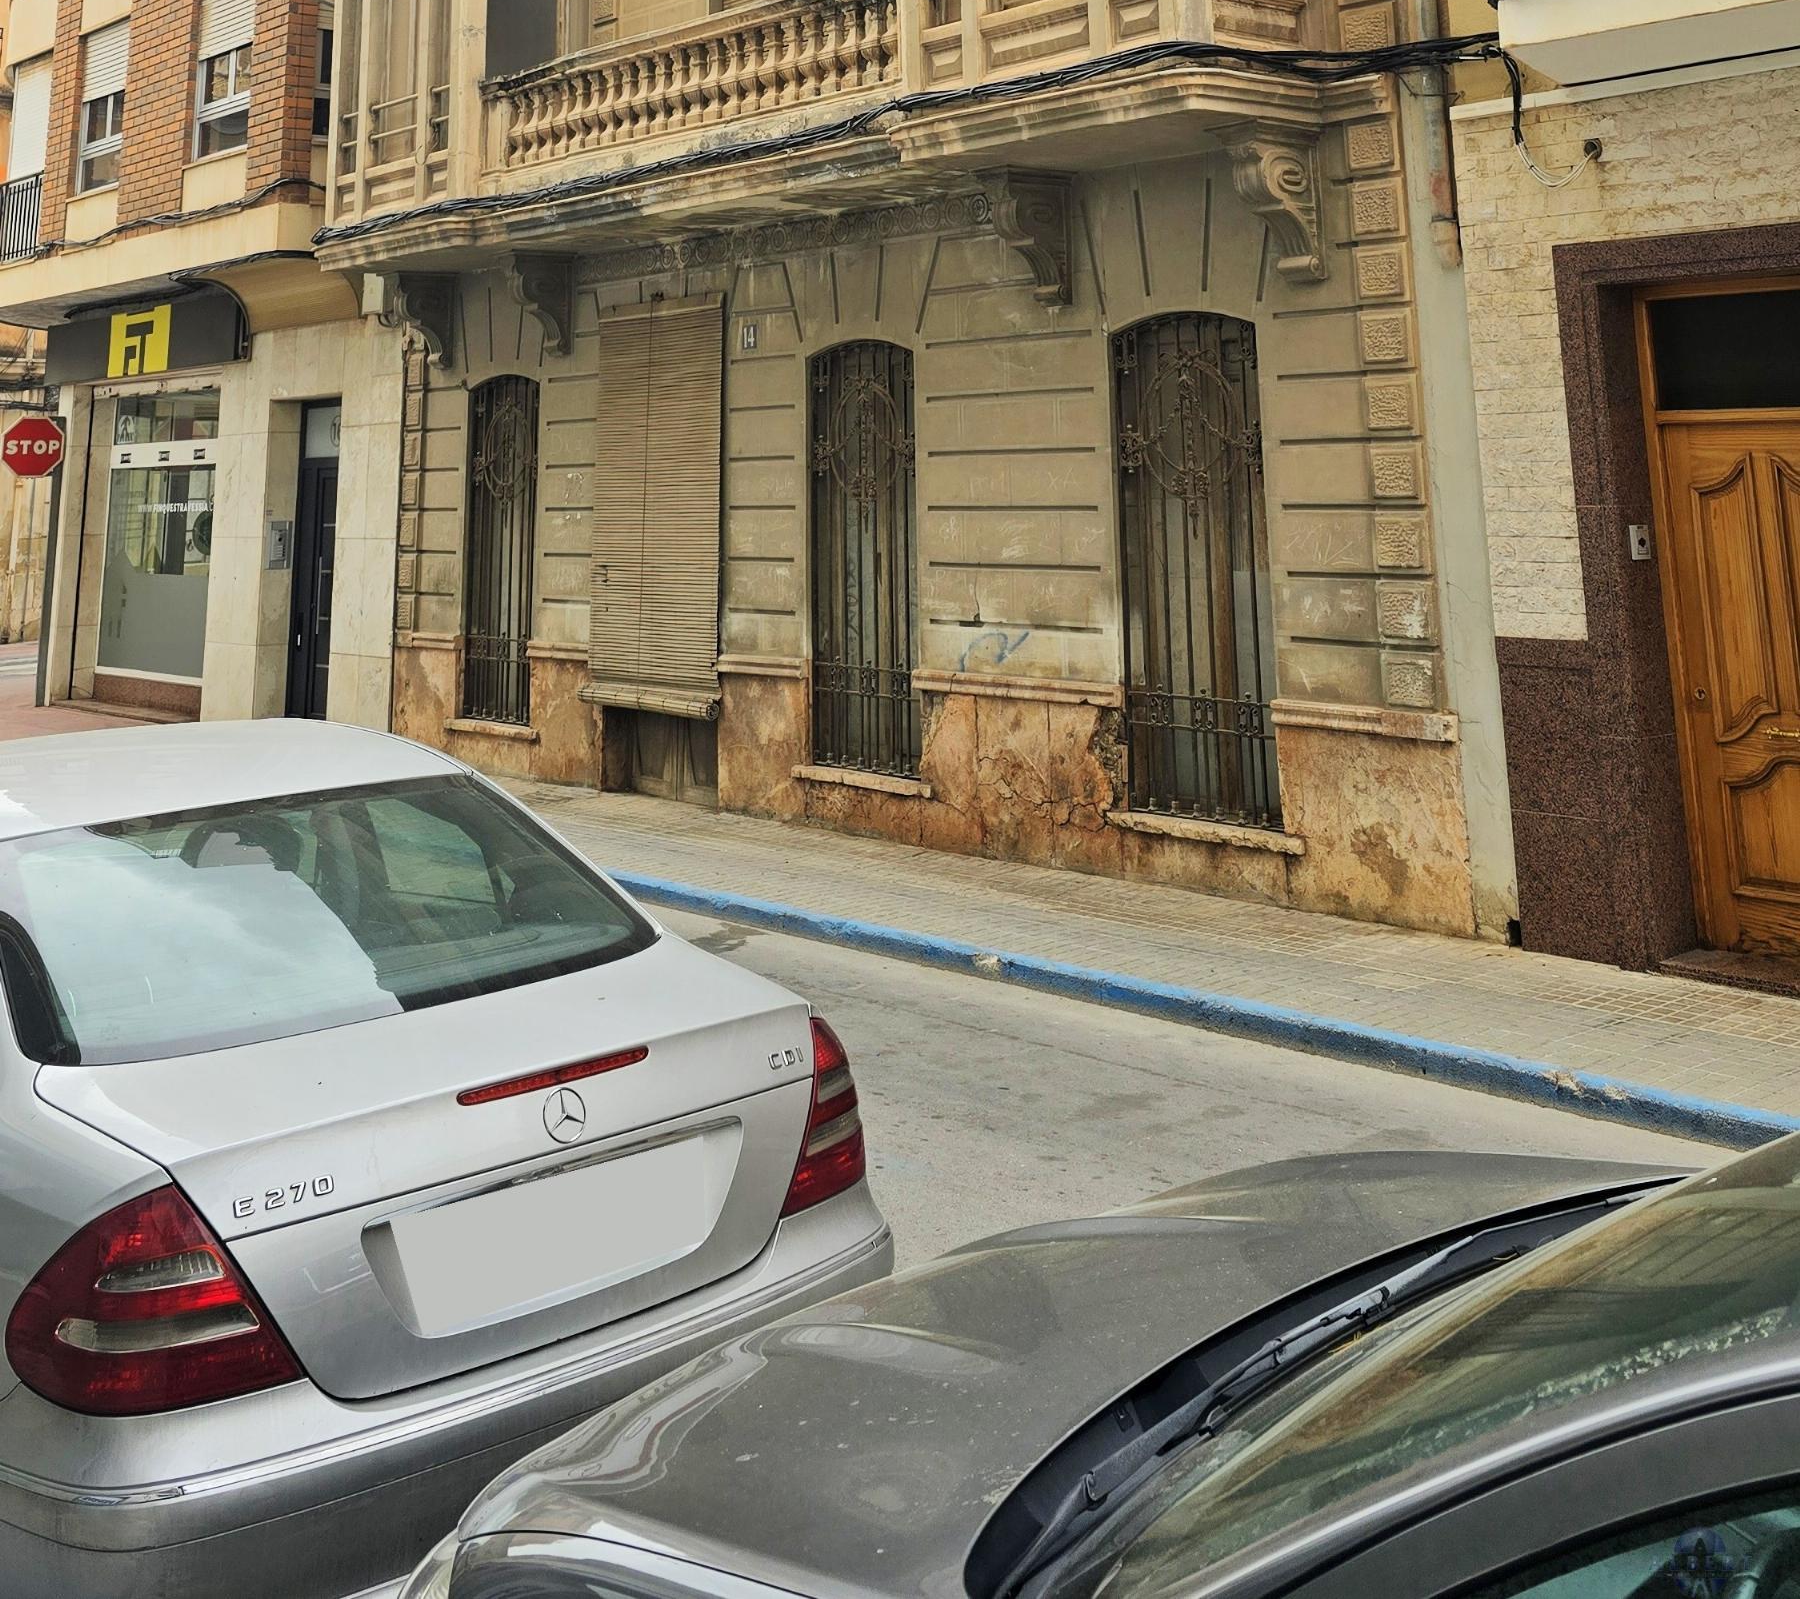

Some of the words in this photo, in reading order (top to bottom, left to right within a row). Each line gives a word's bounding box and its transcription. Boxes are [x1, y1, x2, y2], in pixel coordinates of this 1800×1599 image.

[743, 326, 755, 348] 14
[5, 439, 60, 455] STOP
[768, 1045, 803, 1070] CDI
[233, 1196, 255, 1218] E
[265, 1174, 334, 1210] 270
